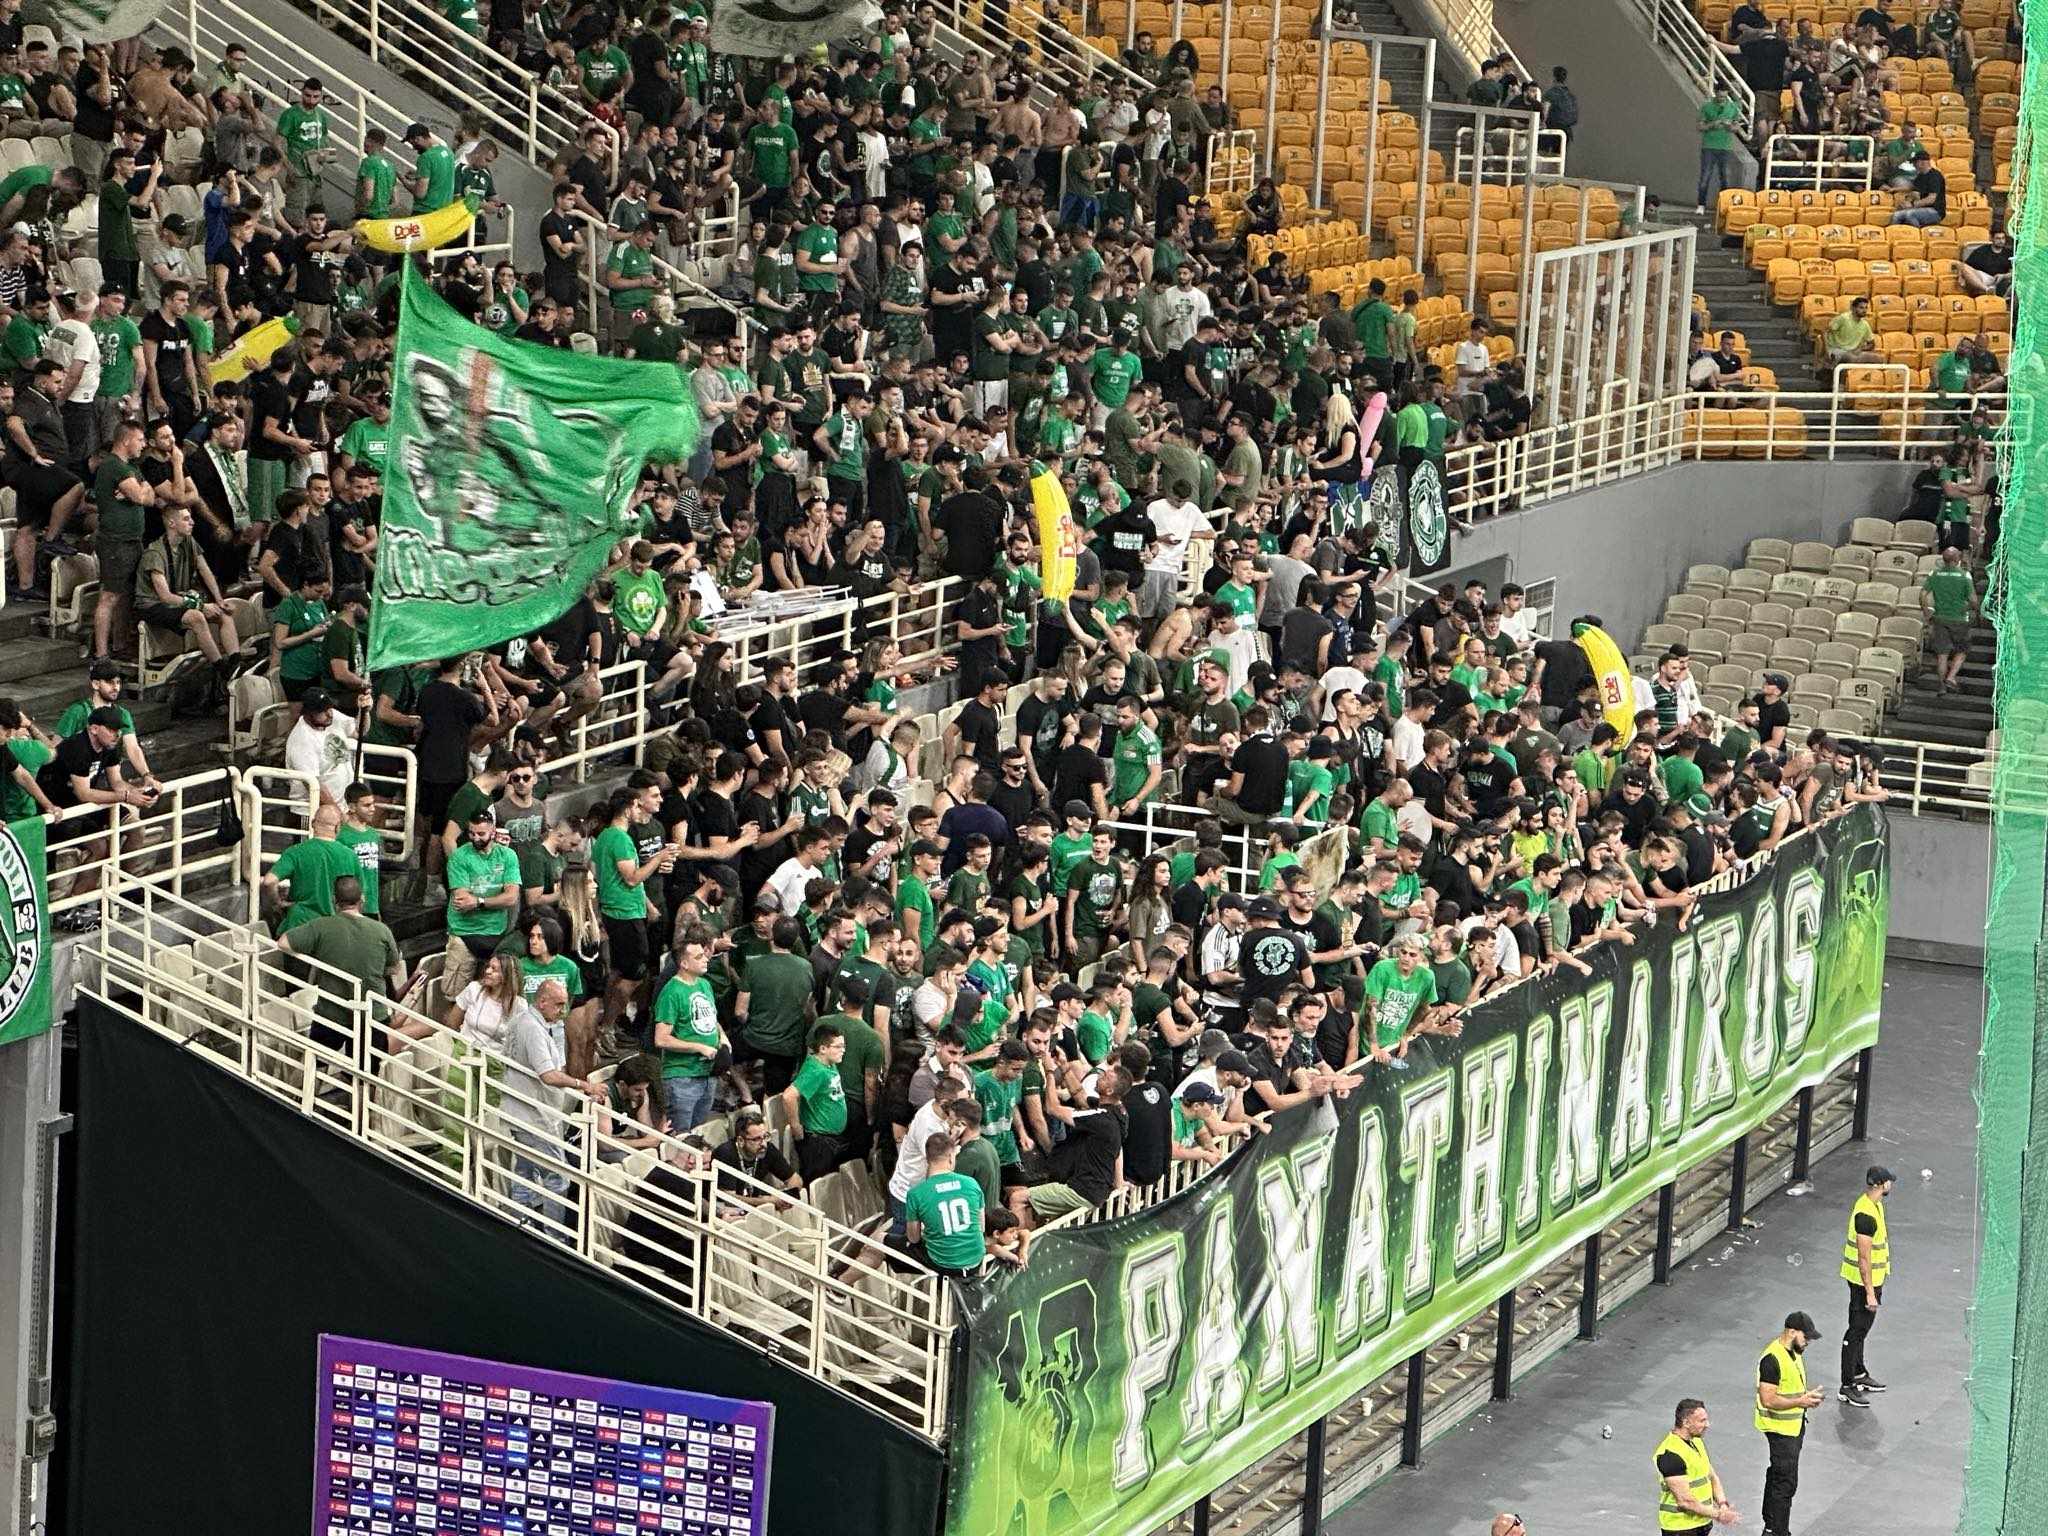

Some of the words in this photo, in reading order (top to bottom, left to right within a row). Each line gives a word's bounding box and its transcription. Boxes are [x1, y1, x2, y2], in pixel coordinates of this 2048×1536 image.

[395, 223, 420, 238] Dole
[1605, 677, 1619, 704] Dole
[13, 903, 36, 934] 13
[1112, 866, 1824, 1492] PANATHINAIKOS
[938, 1197, 971, 1236] 10
